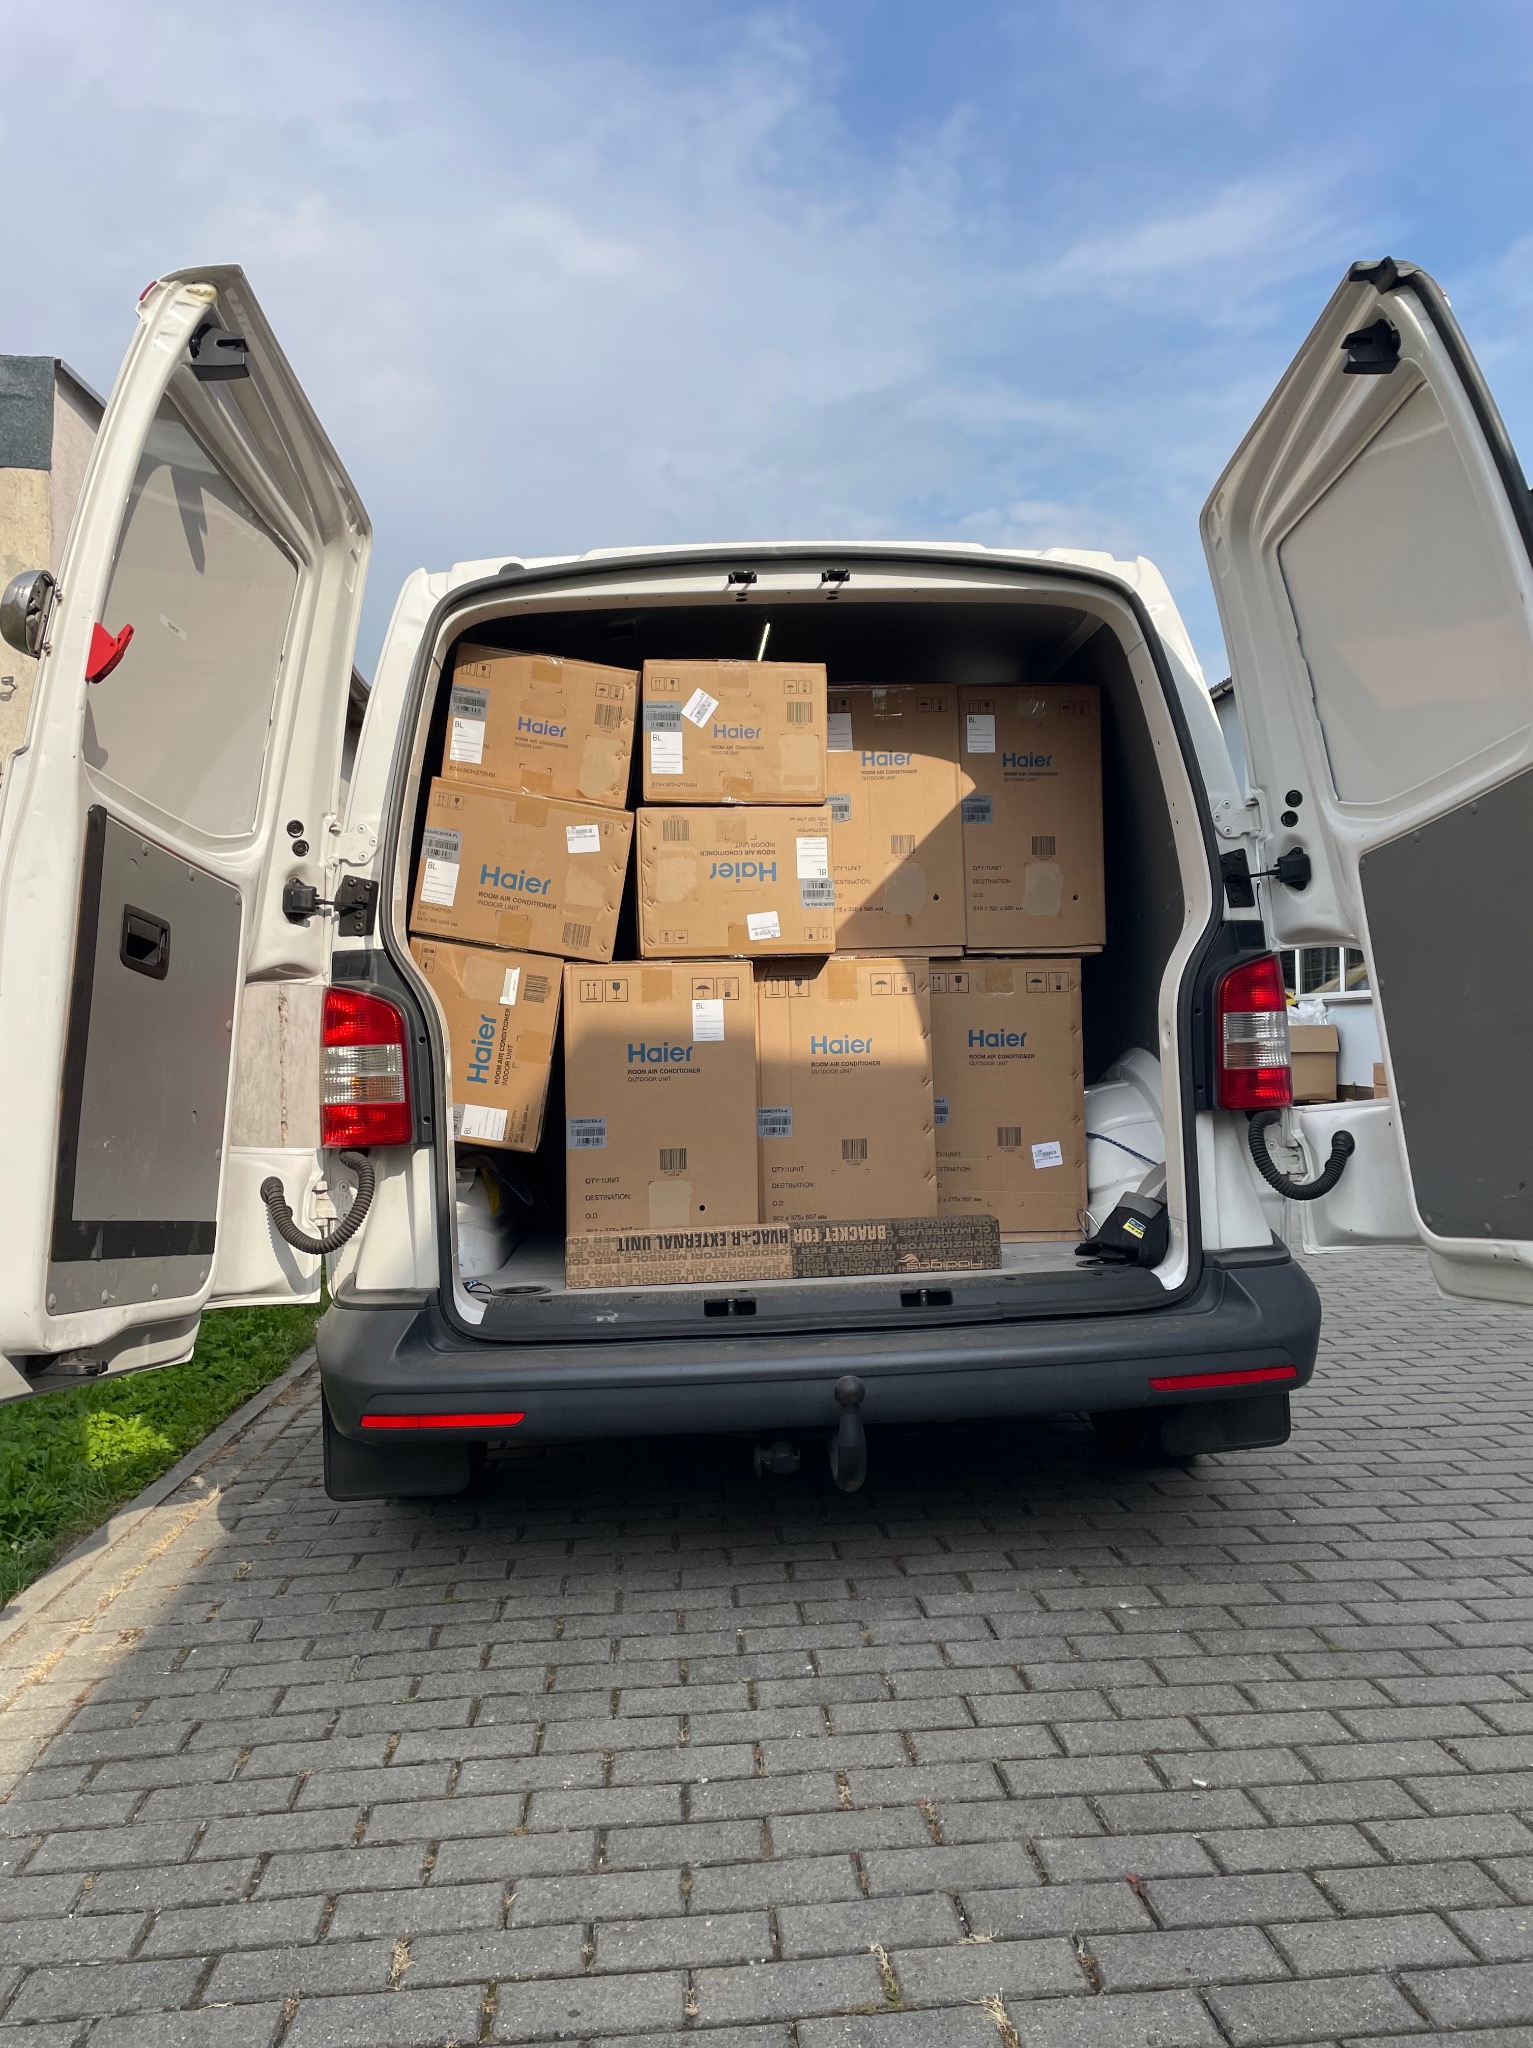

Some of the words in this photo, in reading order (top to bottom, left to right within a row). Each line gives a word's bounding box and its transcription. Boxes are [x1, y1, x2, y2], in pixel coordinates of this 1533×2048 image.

[455, 720, 464, 728] BL
[518, 716, 566, 737] Haier
[714, 724, 762, 738] Haier
[540, 740, 568, 749] CONDITIONER
[861, 750, 912, 766] Haier
[1002, 752, 1052, 768] Haier
[428, 862, 437, 870] BL
[710, 862, 776, 883] Haier
[480, 864, 552, 895] Haier
[477, 900, 502, 909] INDOOR
[479, 892, 498, 900] ROOM
[513, 898, 558, 910] CONDITIONER
[968, 1028, 1027, 1048] Haier
[466, 1014, 496, 1084] Haier
[494, 1064, 502, 1084] ROOM
[500, 1008, 511, 1052] CONDITIONER
[811, 1034, 872, 1054] Haier
[628, 1042, 694, 1062] Haier
[502, 1060, 510, 1086] INDOOR
[464, 1126, 472, 1134] BL
[794, 1228, 819, 1243] FOR
[824, 1225, 886, 1241] BRACKET
[899, 1226, 991, 1236] CLIMATISEURS
[617, 1236, 650, 1251] UNIT
[656, 1232, 726, 1250] EXTERNAL
[732, 1230, 788, 1246] HVAC+R
[831, 1244, 892, 1253] MENSOLE
[897, 1240, 998, 1250] CONDIZIONATORI
[624, 1253, 687, 1263] MENSOLE
[691, 1248, 797, 1259] CONDIZIONATORI
[616, 1262, 685, 1271] CONSOLES
[690, 1258, 784, 1268] CLIMATISEURS
[785, 1260, 875, 1270] CONDITIONING
[907, 1259, 982, 1270] Rodigas
[589, 1269, 681, 1280] CONDITIONING
[712, 1264, 780, 1274] BRACKETS
[832, 1266, 894, 1276] MENSOLE
[624, 1275, 688, 1285] MENSOLE
[693, 1270, 798, 1281] CONDIZIONATORI
